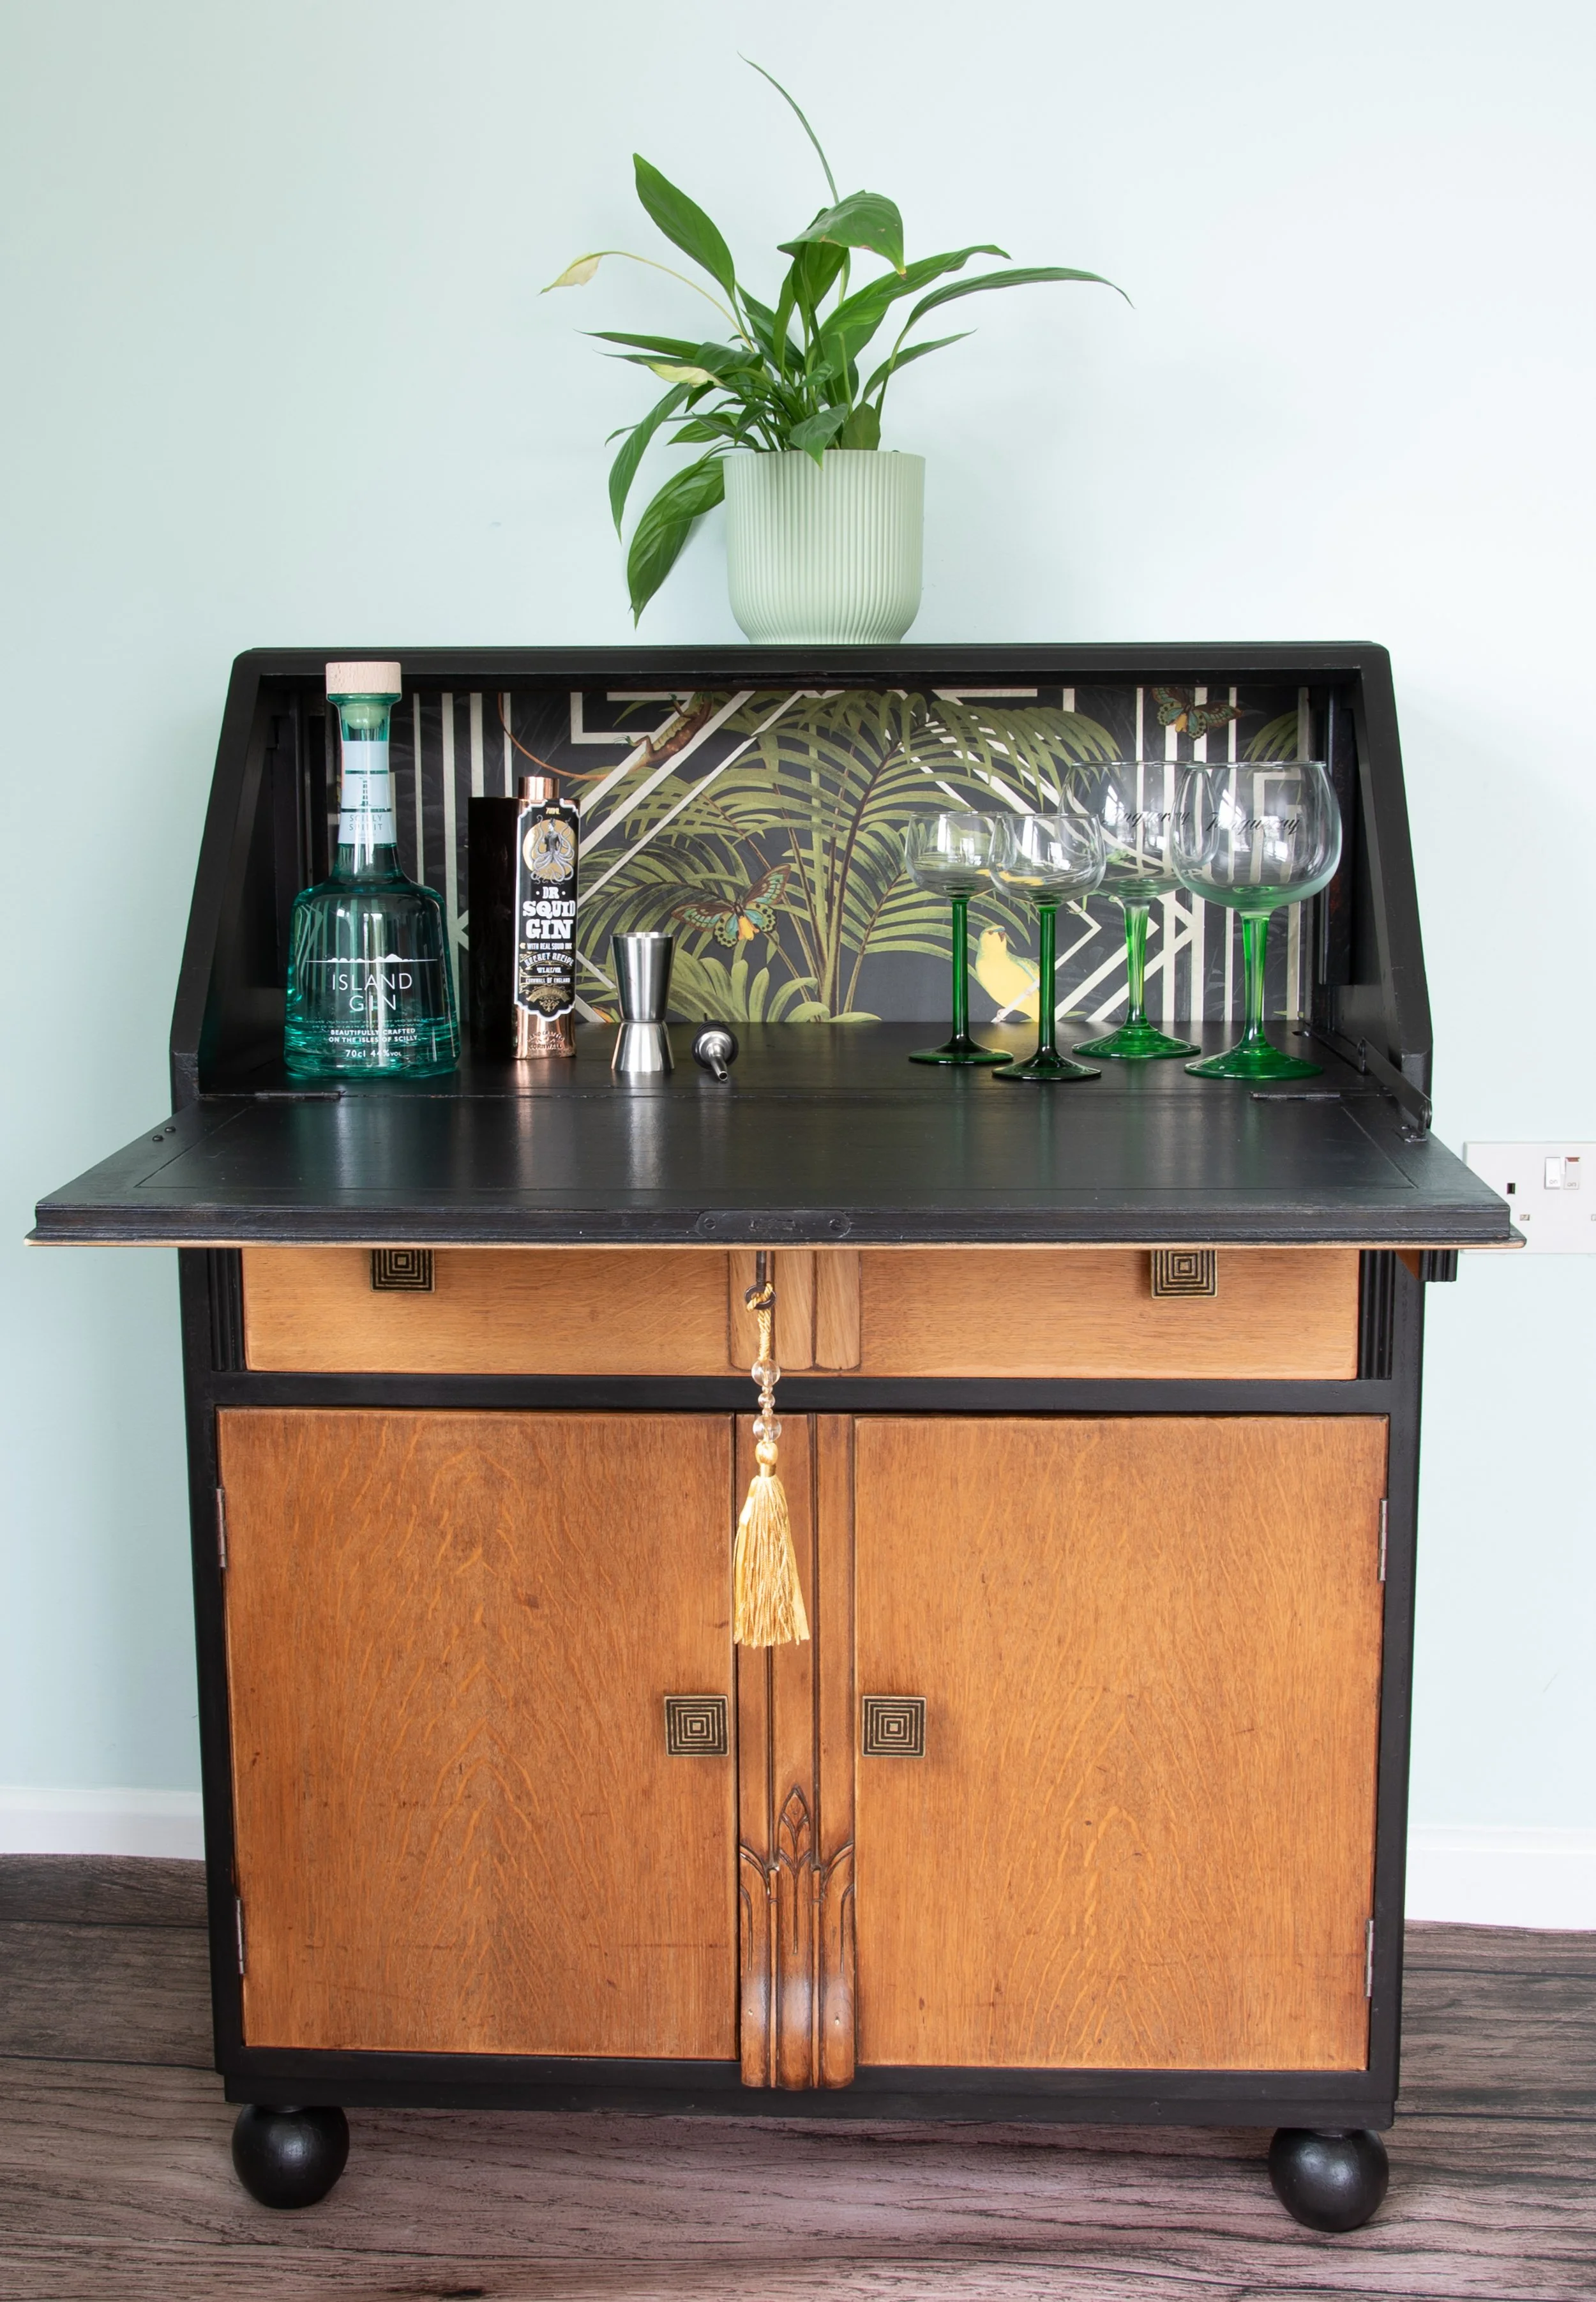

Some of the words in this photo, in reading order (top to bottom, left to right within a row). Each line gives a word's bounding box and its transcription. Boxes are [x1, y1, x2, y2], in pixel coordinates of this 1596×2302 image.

[542, 886, 560, 899] DR
[522, 900, 576, 919] SQUID
[525, 919, 574, 939] GIN
[552, 952, 574, 967] RECIPE
[332, 973, 412, 990] ISLAND
[349, 994, 396, 1012] GIN
[345, 1049, 366, 1058] 70cl
